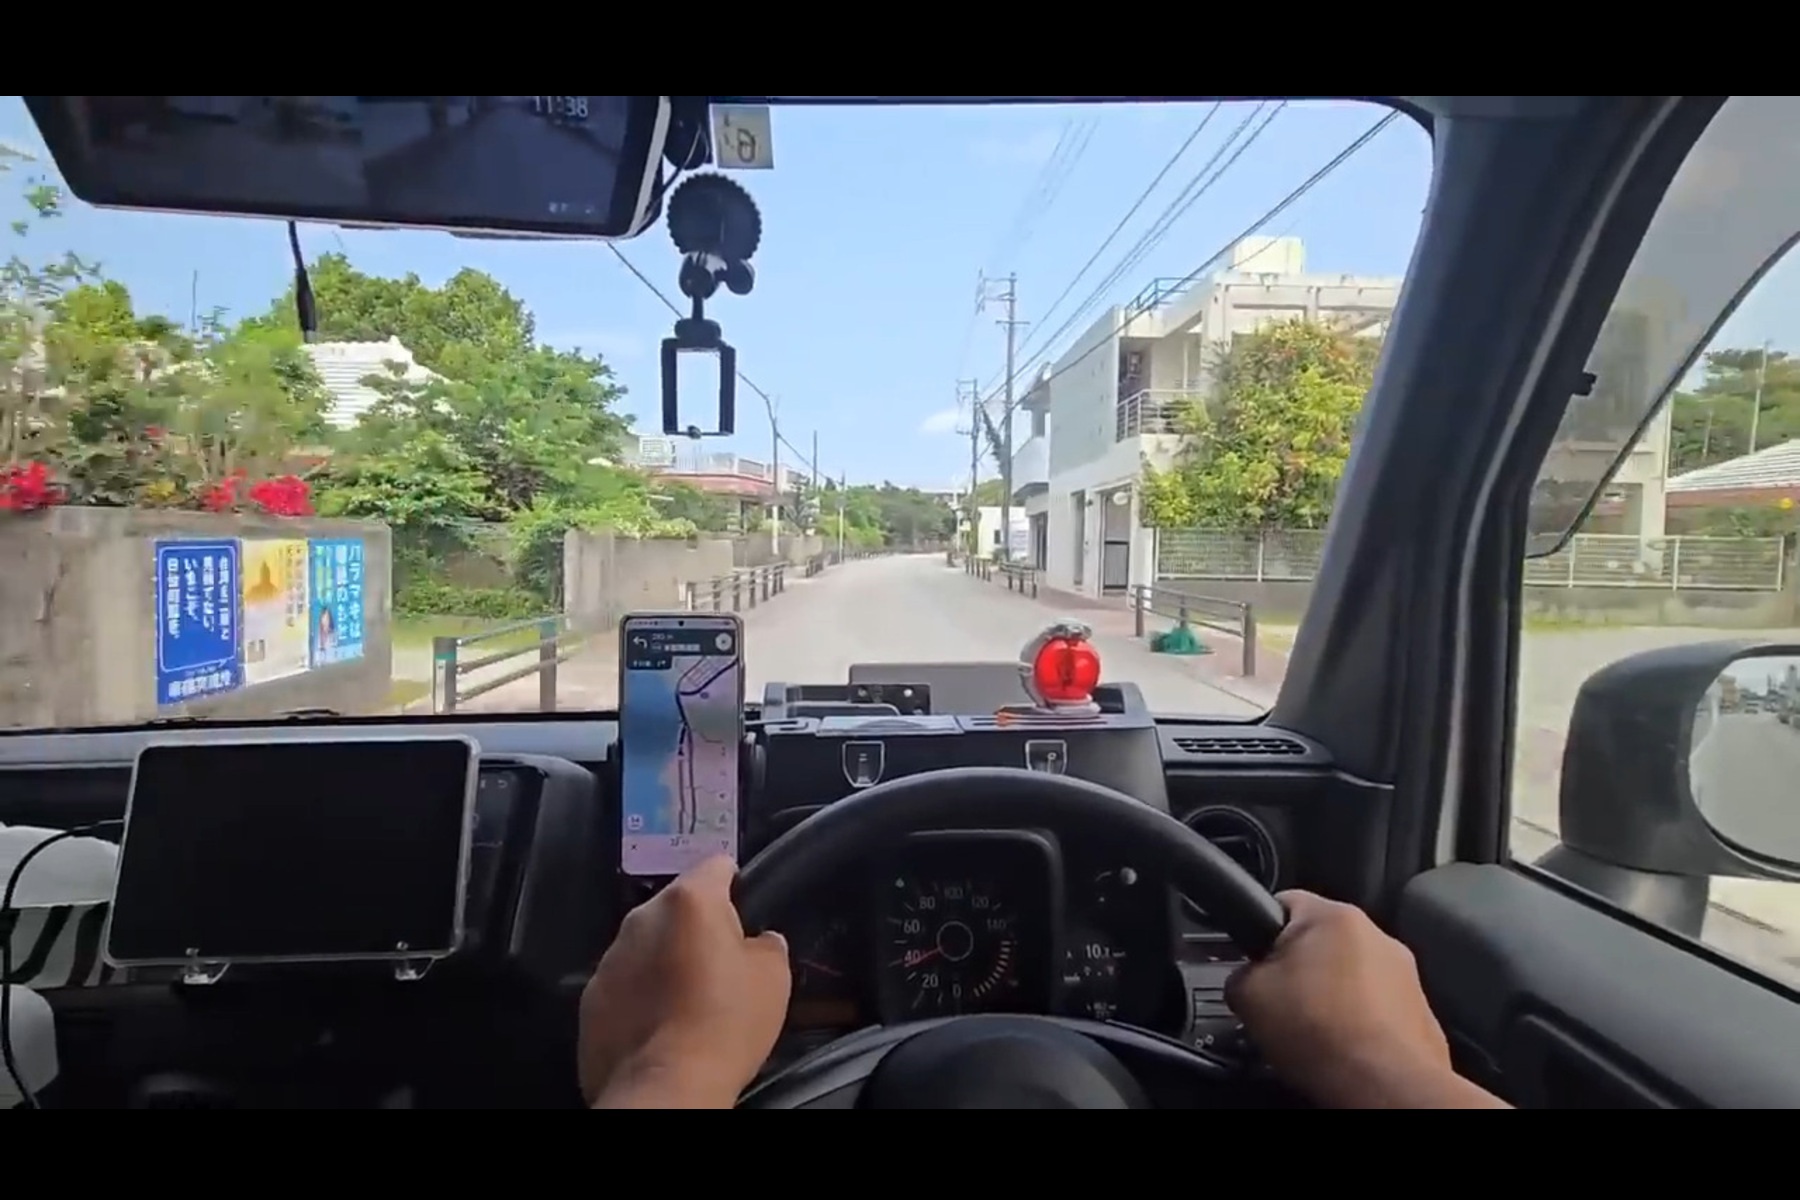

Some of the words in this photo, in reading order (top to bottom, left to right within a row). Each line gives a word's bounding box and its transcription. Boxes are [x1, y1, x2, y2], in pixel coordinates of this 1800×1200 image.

[532, 96, 589, 117] 11:38
[944, 886, 964, 899] 100
[919, 896, 936, 910] 80
[971, 897, 989, 909] 120
[903, 919, 921, 934] 60
[987, 918, 1007, 931] 140
[904, 950, 921, 963] 40
[922, 973, 939, 988] 20
[952, 984, 962, 998] 0
